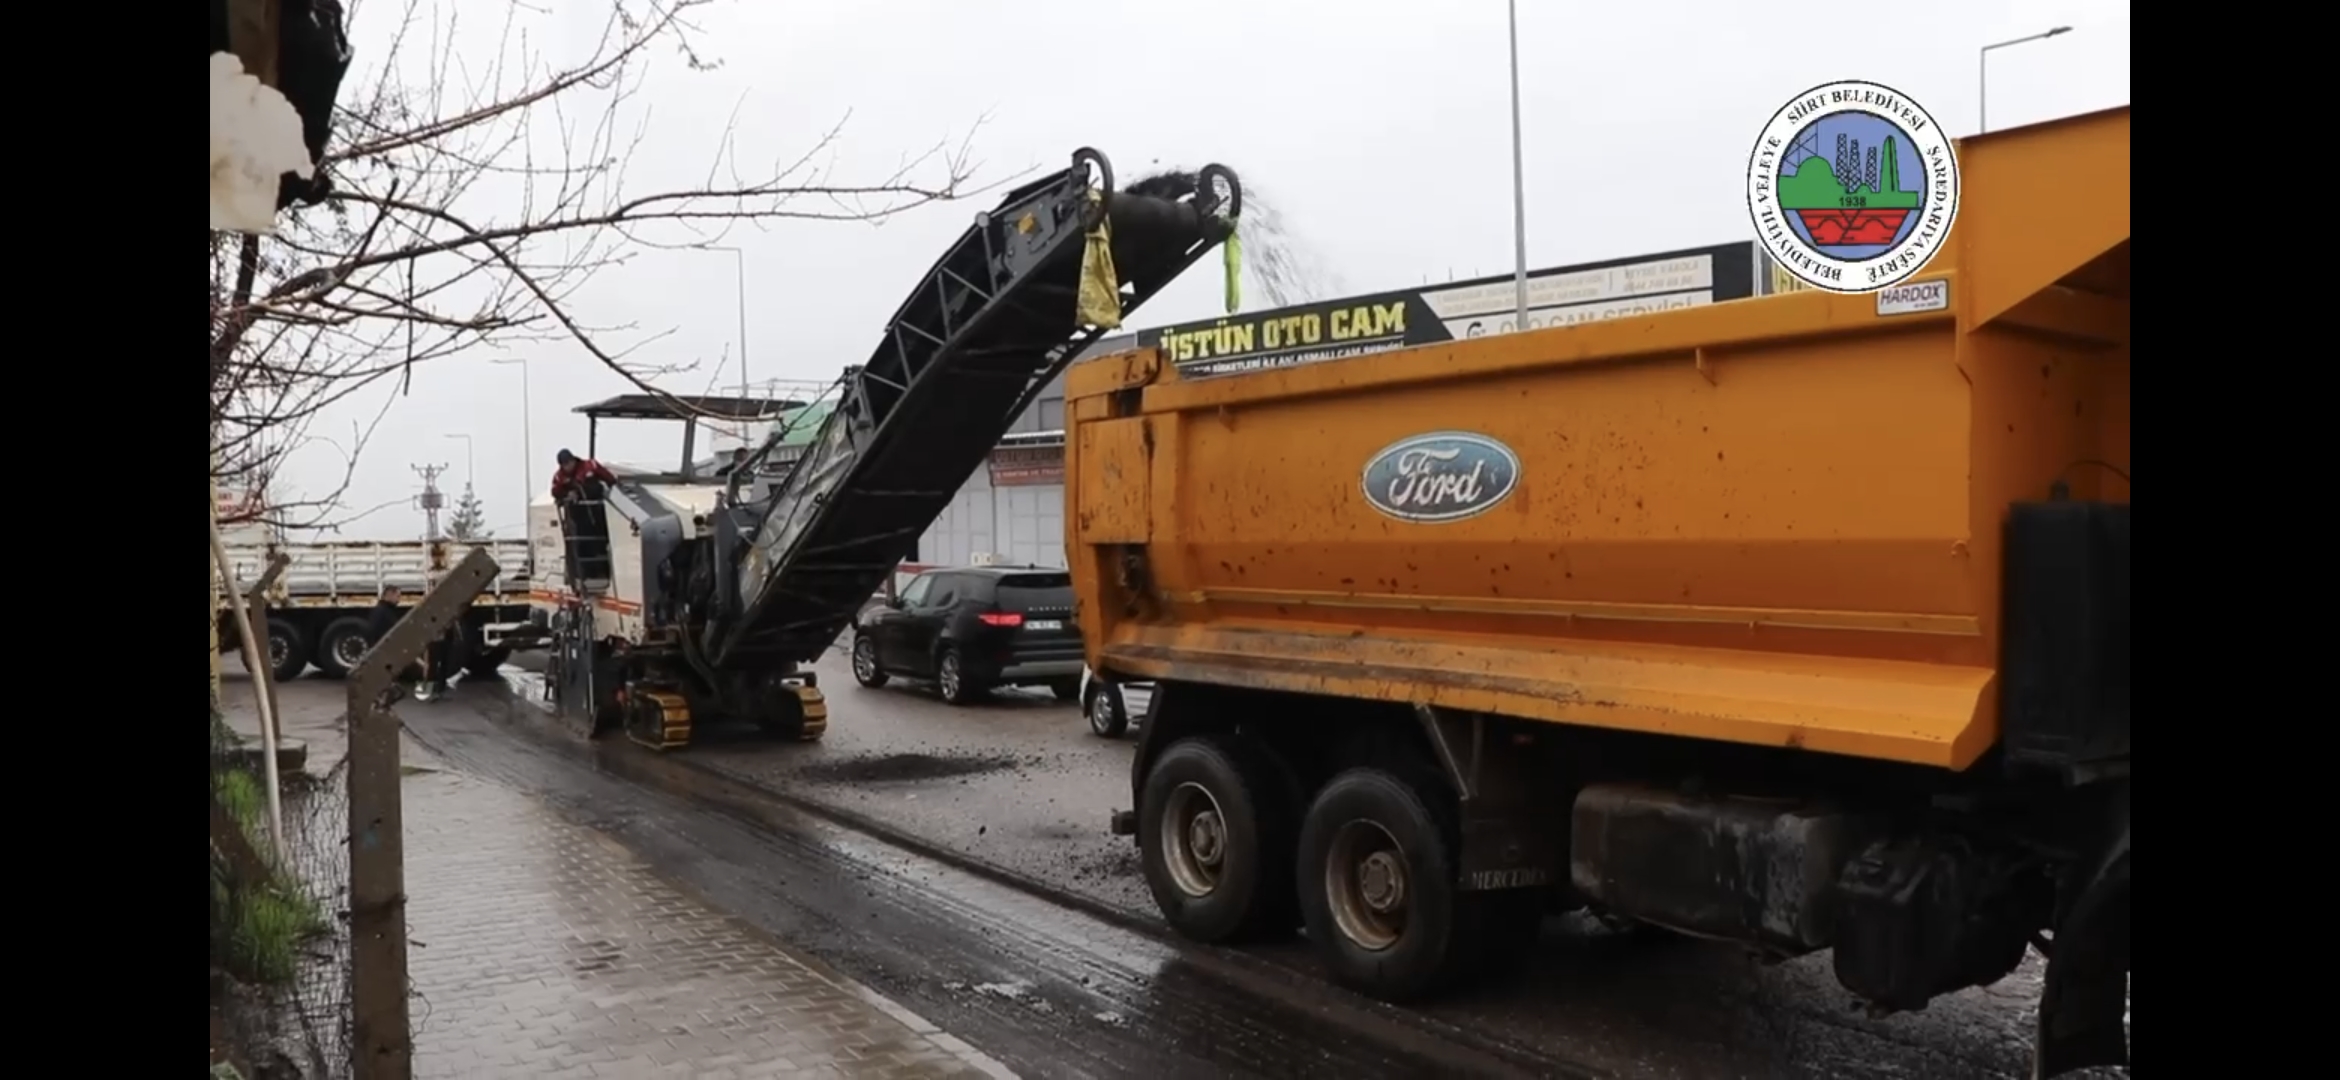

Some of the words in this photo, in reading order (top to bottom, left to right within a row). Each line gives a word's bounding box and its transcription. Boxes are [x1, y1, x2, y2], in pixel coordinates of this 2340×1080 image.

[1881, 284, 1940, 305] HARDOX
[1161, 320, 1254, 362] ÜSTÜN
[1263, 313, 1321, 349] OTO
[1331, 302, 1405, 340] CAM
[1389, 447, 1484, 506] Ford
